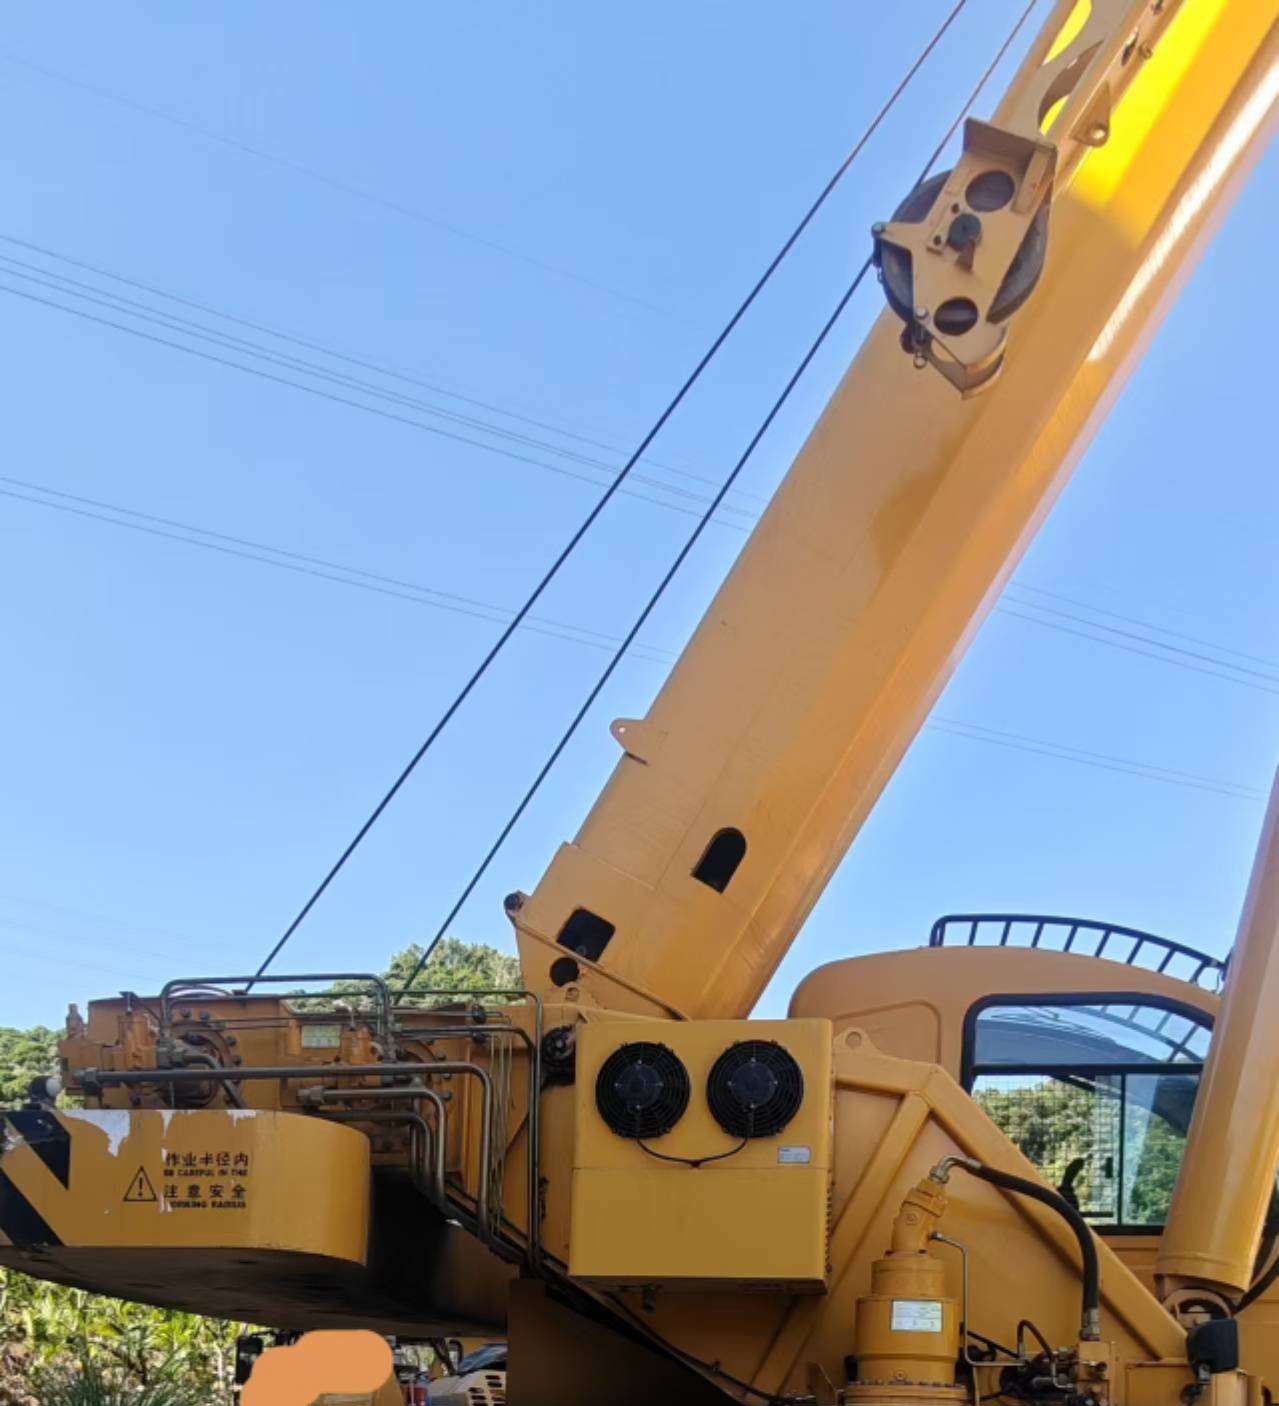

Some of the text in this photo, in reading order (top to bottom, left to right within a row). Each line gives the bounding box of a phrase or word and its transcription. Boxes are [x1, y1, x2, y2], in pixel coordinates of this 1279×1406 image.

[165, 1151, 248, 1166] 作业半径内
[164, 1184, 246, 1198] 注意安全
